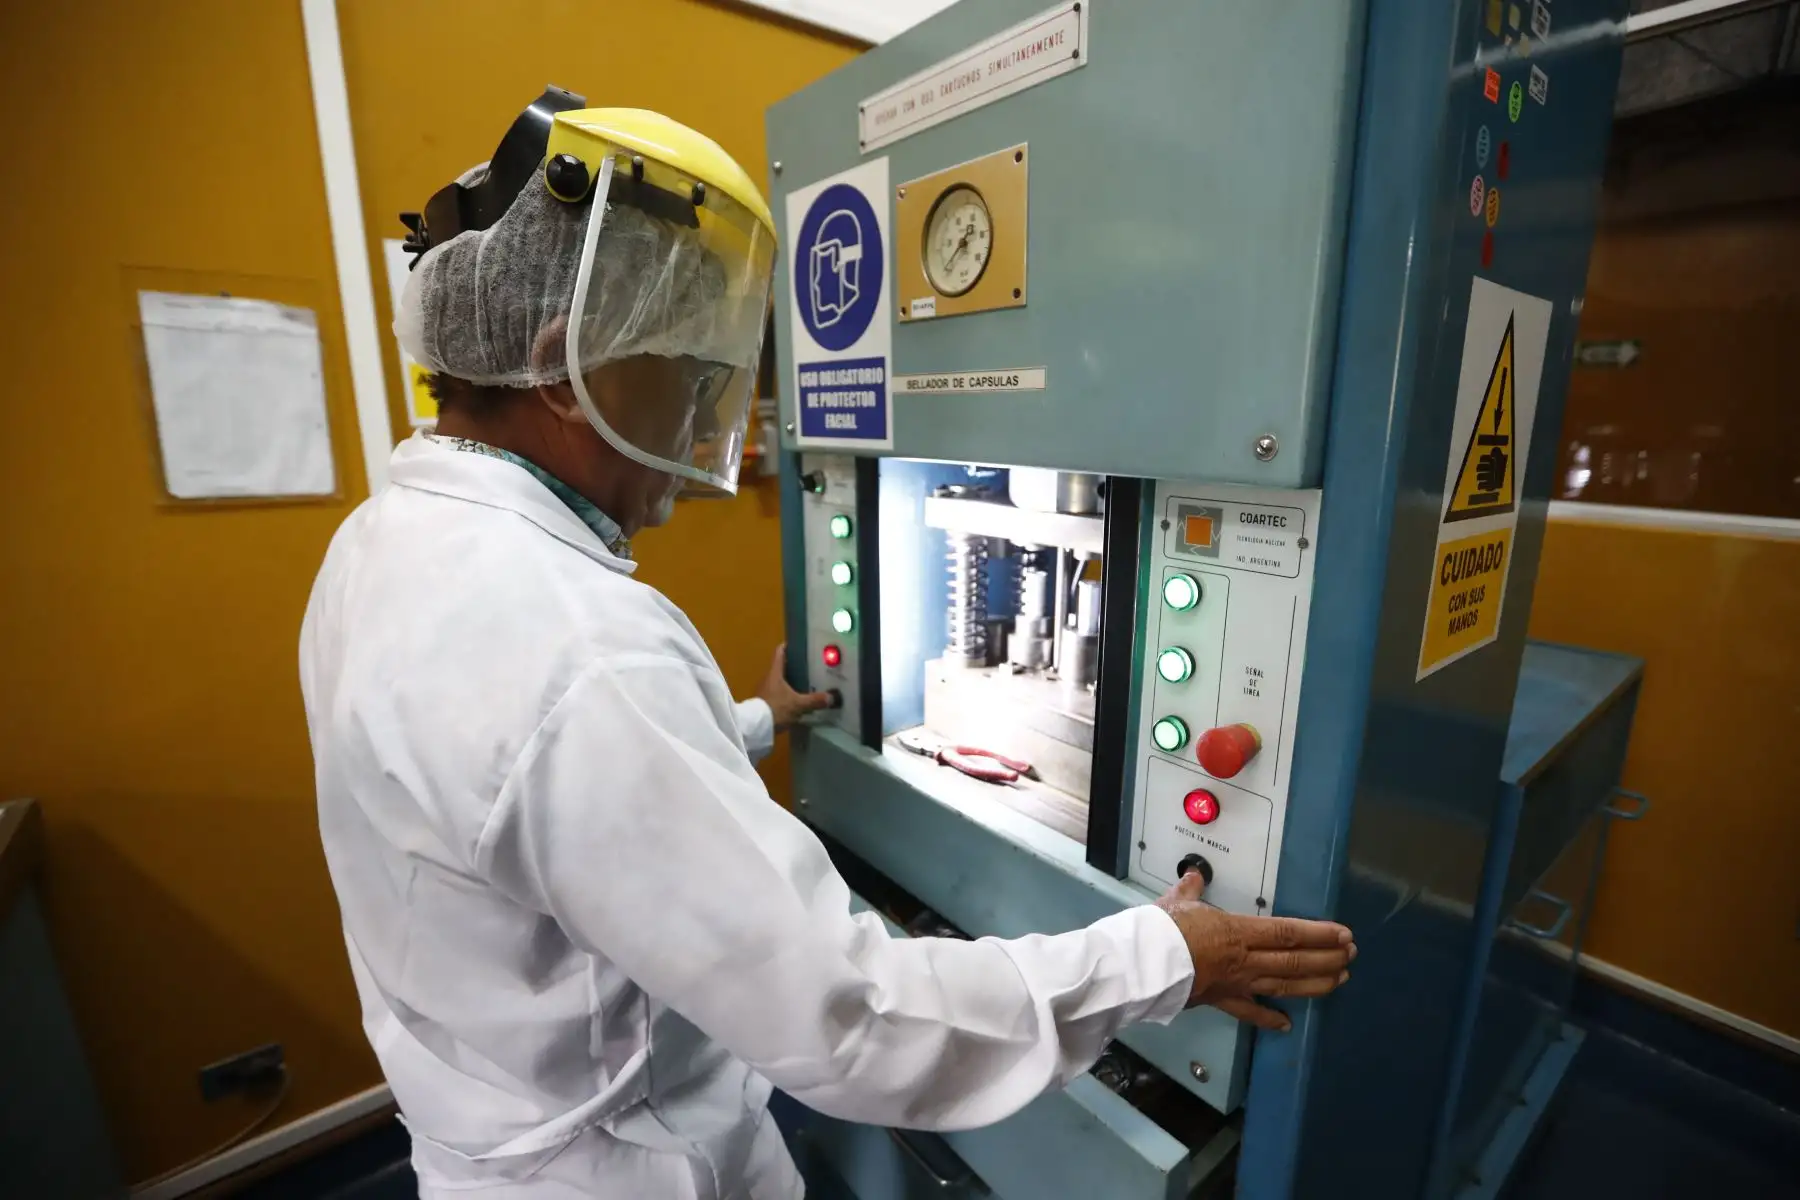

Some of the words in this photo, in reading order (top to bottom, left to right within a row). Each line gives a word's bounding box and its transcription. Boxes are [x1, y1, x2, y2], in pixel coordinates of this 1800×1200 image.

[988, 29, 1065, 76] SIMULTANEAMENTE
[800, 371, 818, 388] USO
[819, 367, 884, 387] OBLIGATORIO
[906, 378, 949, 390] SELLADOR
[953, 377, 965, 388] DE
[969, 375, 1020, 388] CAPSULAS
[807, 392, 820, 408] DE
[820, 390, 876, 408] PROTECTOR
[825, 413, 858, 429] FACIAL
[1239, 511, 1287, 528] COARTEC
[1250, 557, 1281, 568] ARGENTINA
[1440, 540, 1504, 586] CUIDADO
[1448, 591, 1468, 613] CON
[1468, 584, 1486, 605] SUS
[1447, 609, 1479, 637] MANOS
[1245, 666, 1264, 679] SEÑAL
[1249, 678, 1257, 687] DE
[1243, 687, 1260, 697] LINEA
[1174, 824, 1195, 838] PUESTA
[1207, 839, 1230, 853] MARCHA
